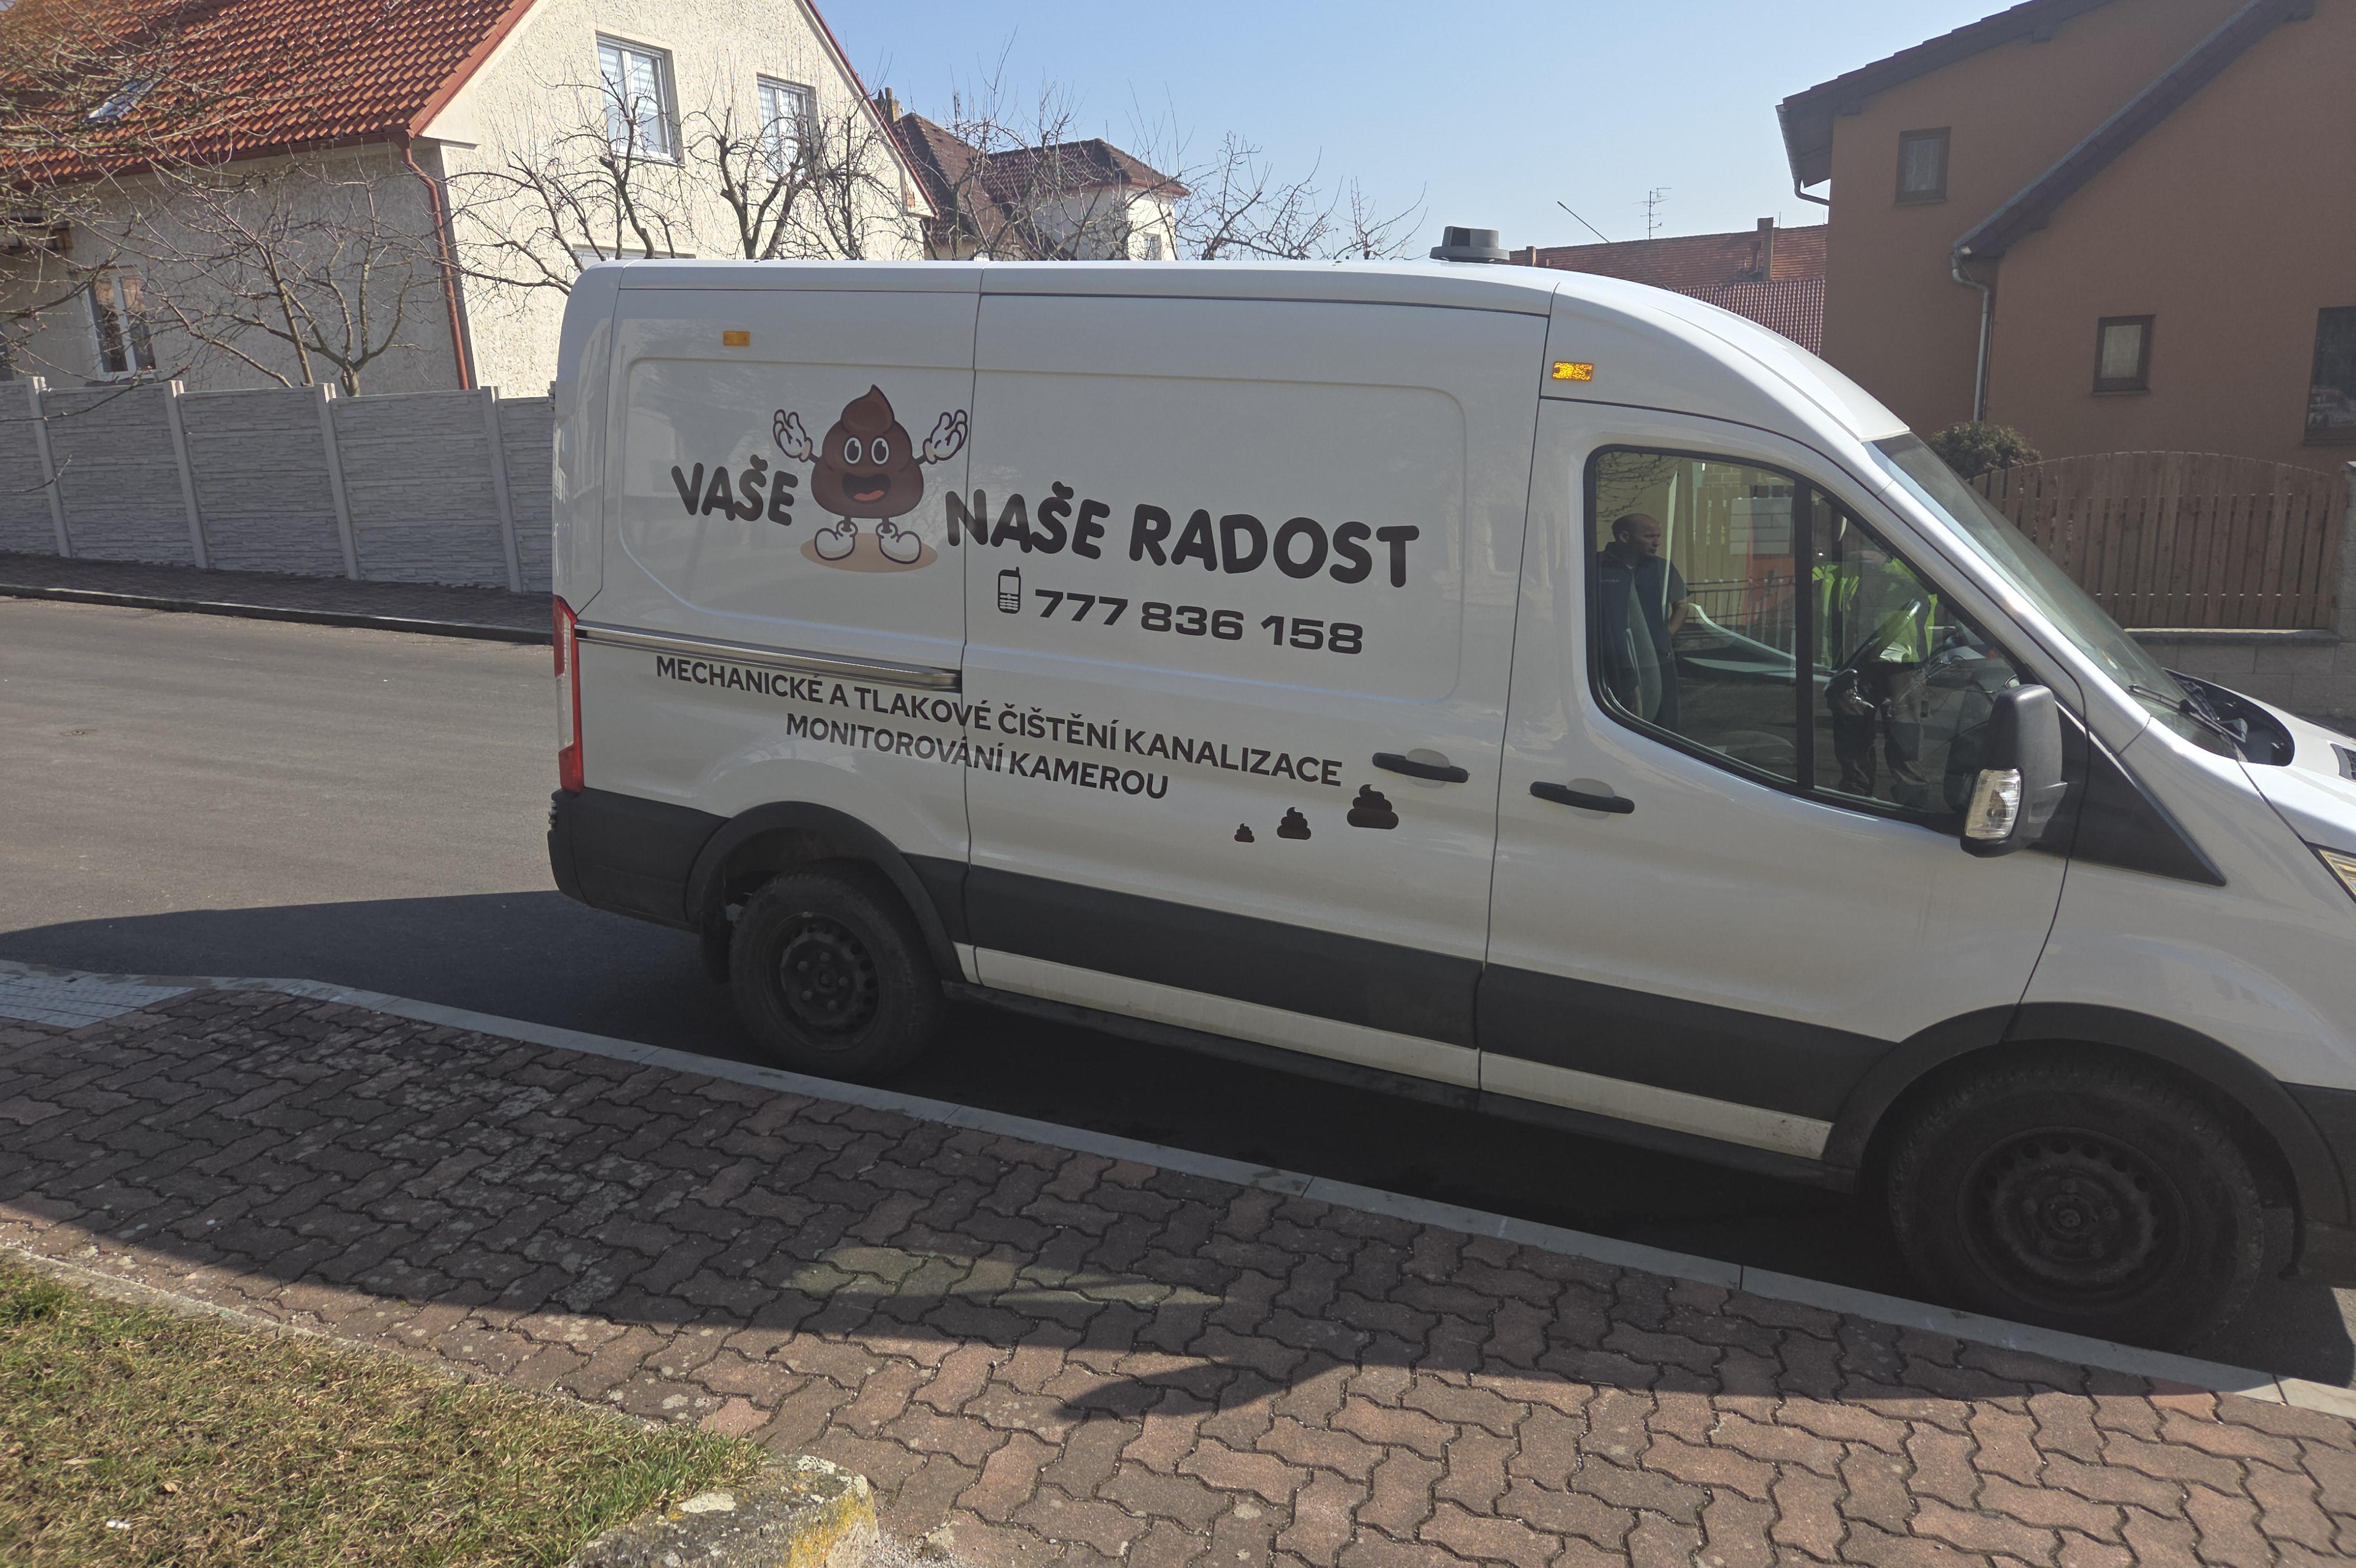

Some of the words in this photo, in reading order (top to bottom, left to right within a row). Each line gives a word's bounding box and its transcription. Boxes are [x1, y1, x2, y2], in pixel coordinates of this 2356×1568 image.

[671, 454, 799, 526] VAŠE
[945, 481, 1111, 560] NAŠE
[1129, 504, 1419, 588] RADOST
[1035, 589, 1129, 625] 777
[1141, 602, 1244, 640] 836
[1260, 616, 1364, 654] 158
[657, 655, 823, 703] MECHANICKÉ
[829, 684, 849, 707] A
[854, 686, 991, 731] TLAKOVÉ
[998, 703, 1120, 750] ČIŠTĚNÍ
[1125, 729, 1343, 787] KANALIZACE
[787, 713, 1004, 773] MONITOROVÁNÍ
[1009, 751, 1169, 799] KAMEROU
